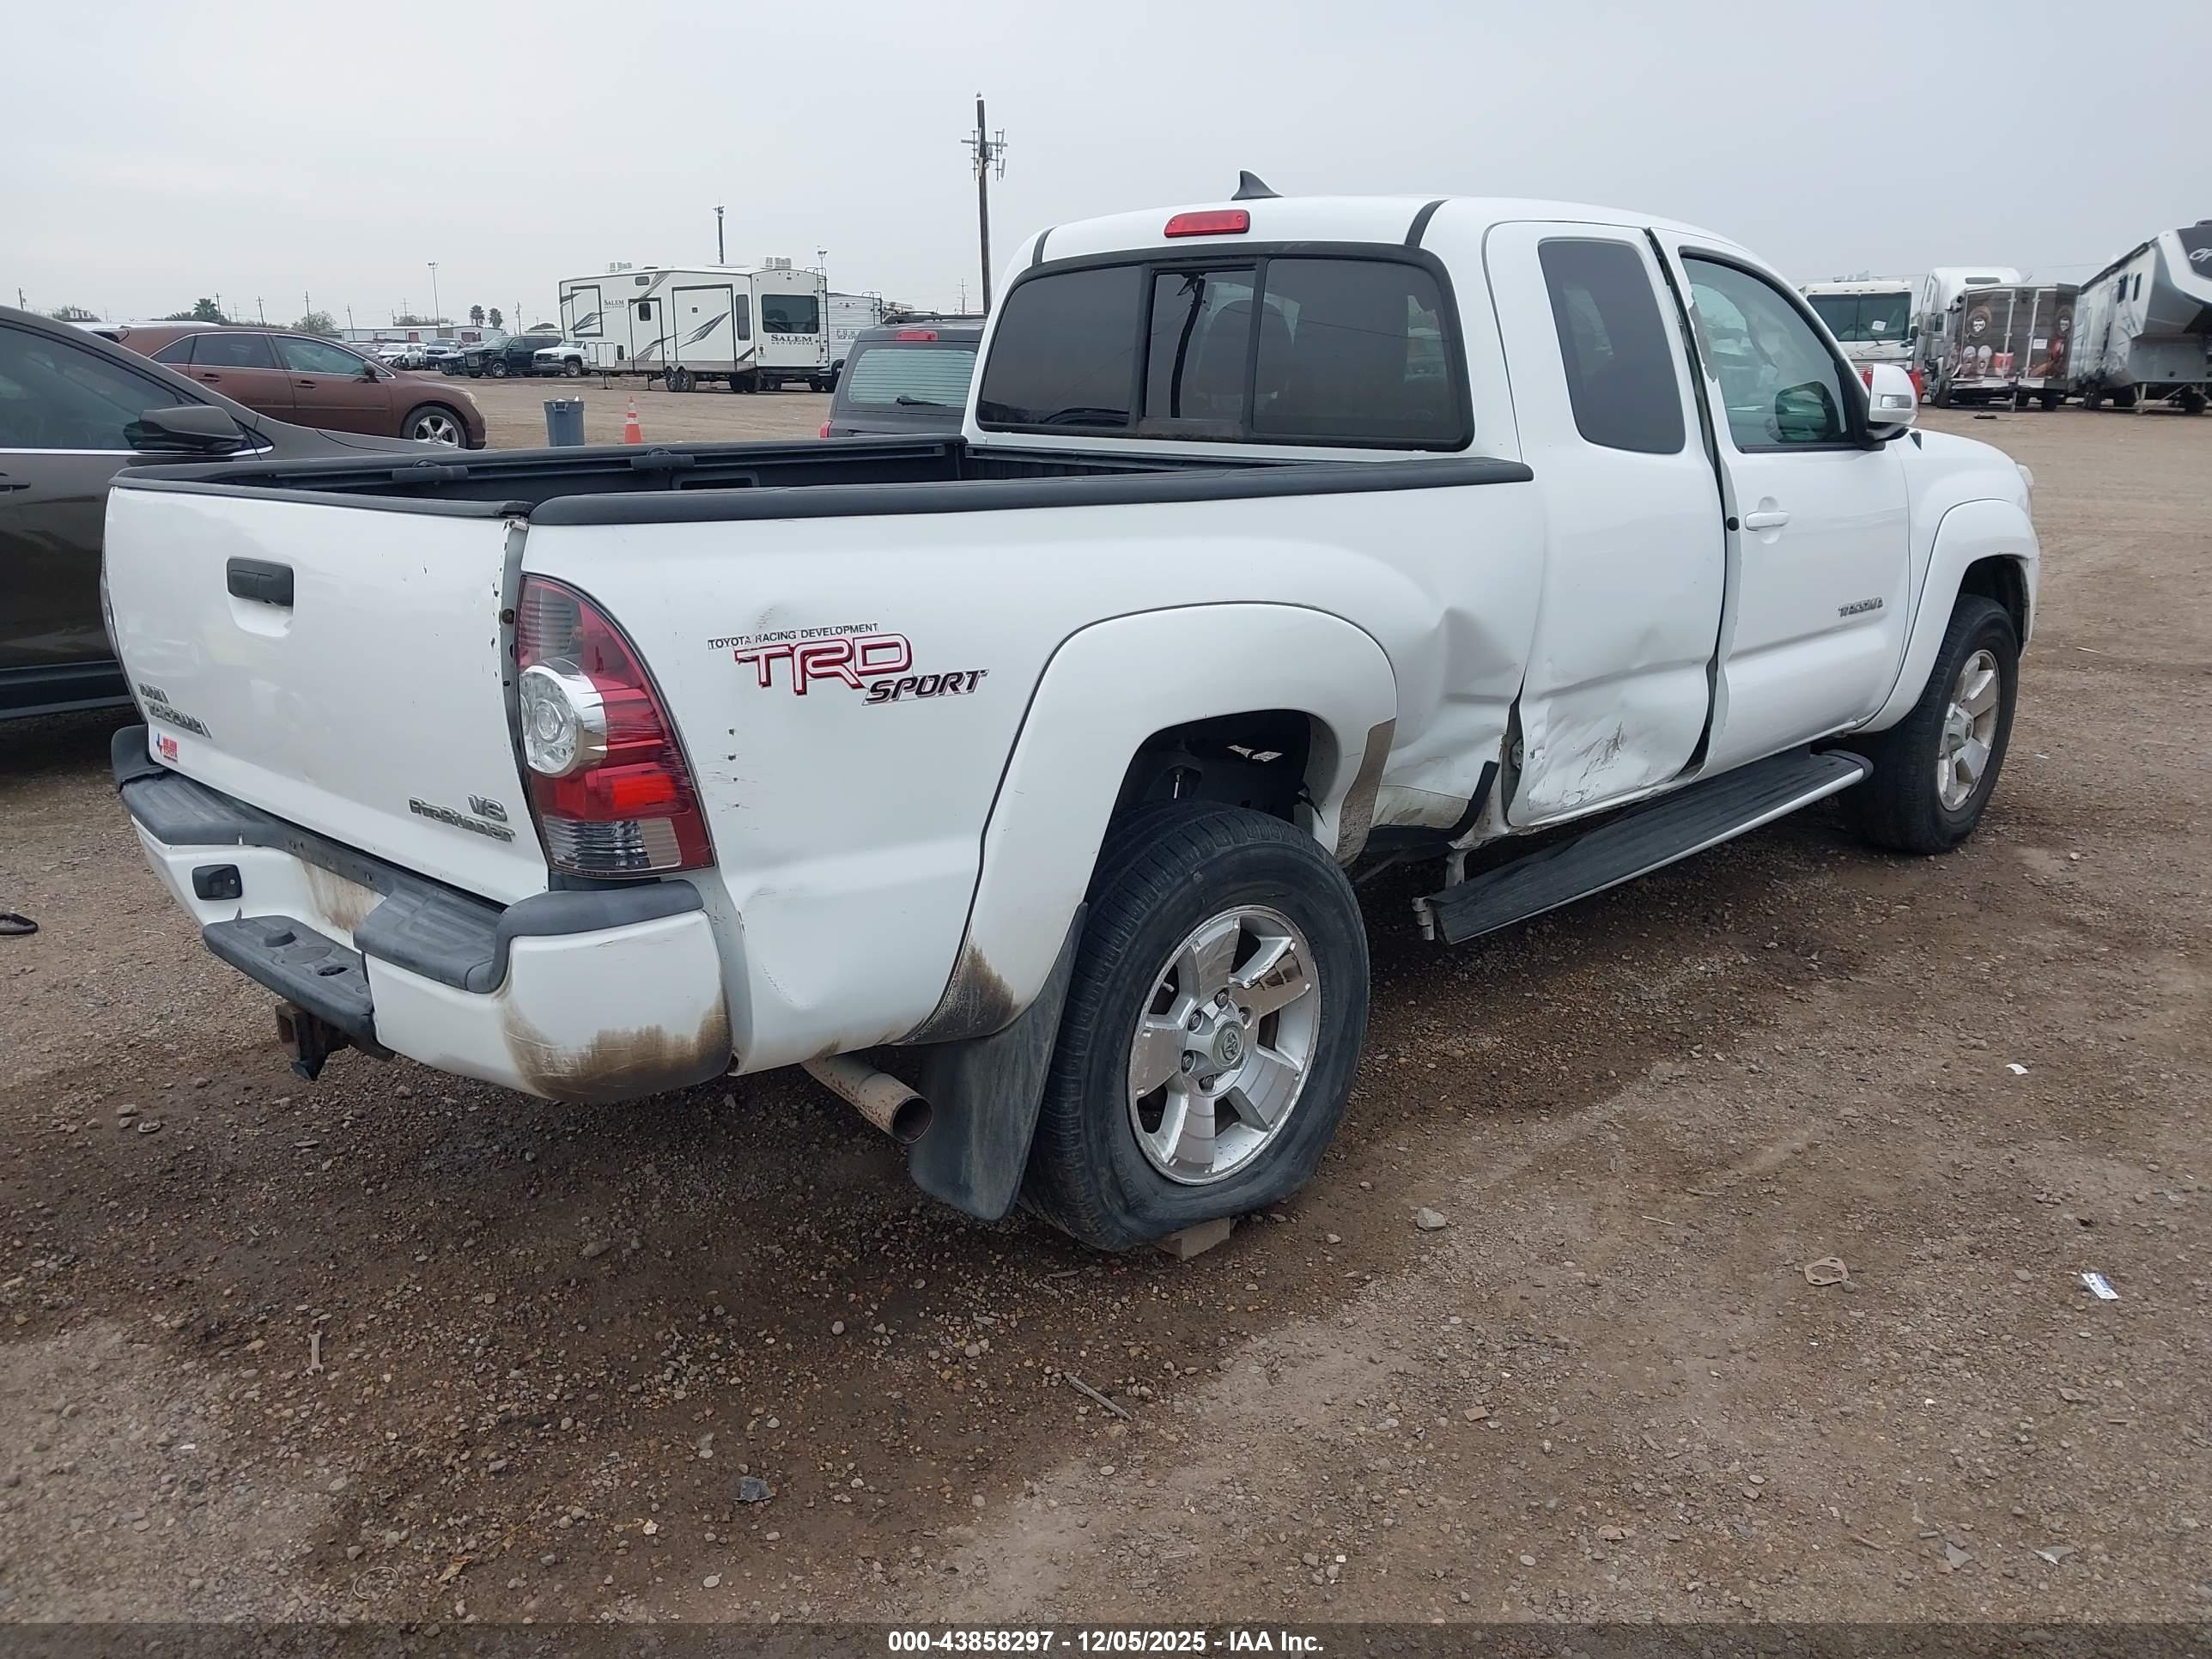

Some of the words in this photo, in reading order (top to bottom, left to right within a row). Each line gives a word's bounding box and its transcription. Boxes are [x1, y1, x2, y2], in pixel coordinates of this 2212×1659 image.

[770, 334, 812, 343] SALEM
[708, 635, 751, 650] TOYOTA
[755, 630, 797, 644] RACING
[800, 623, 878, 639] DEVELOPMENT
[734, 632, 914, 696] TRD
[863, 670, 989, 705] SPORT
[468, 793, 507, 822] V6
